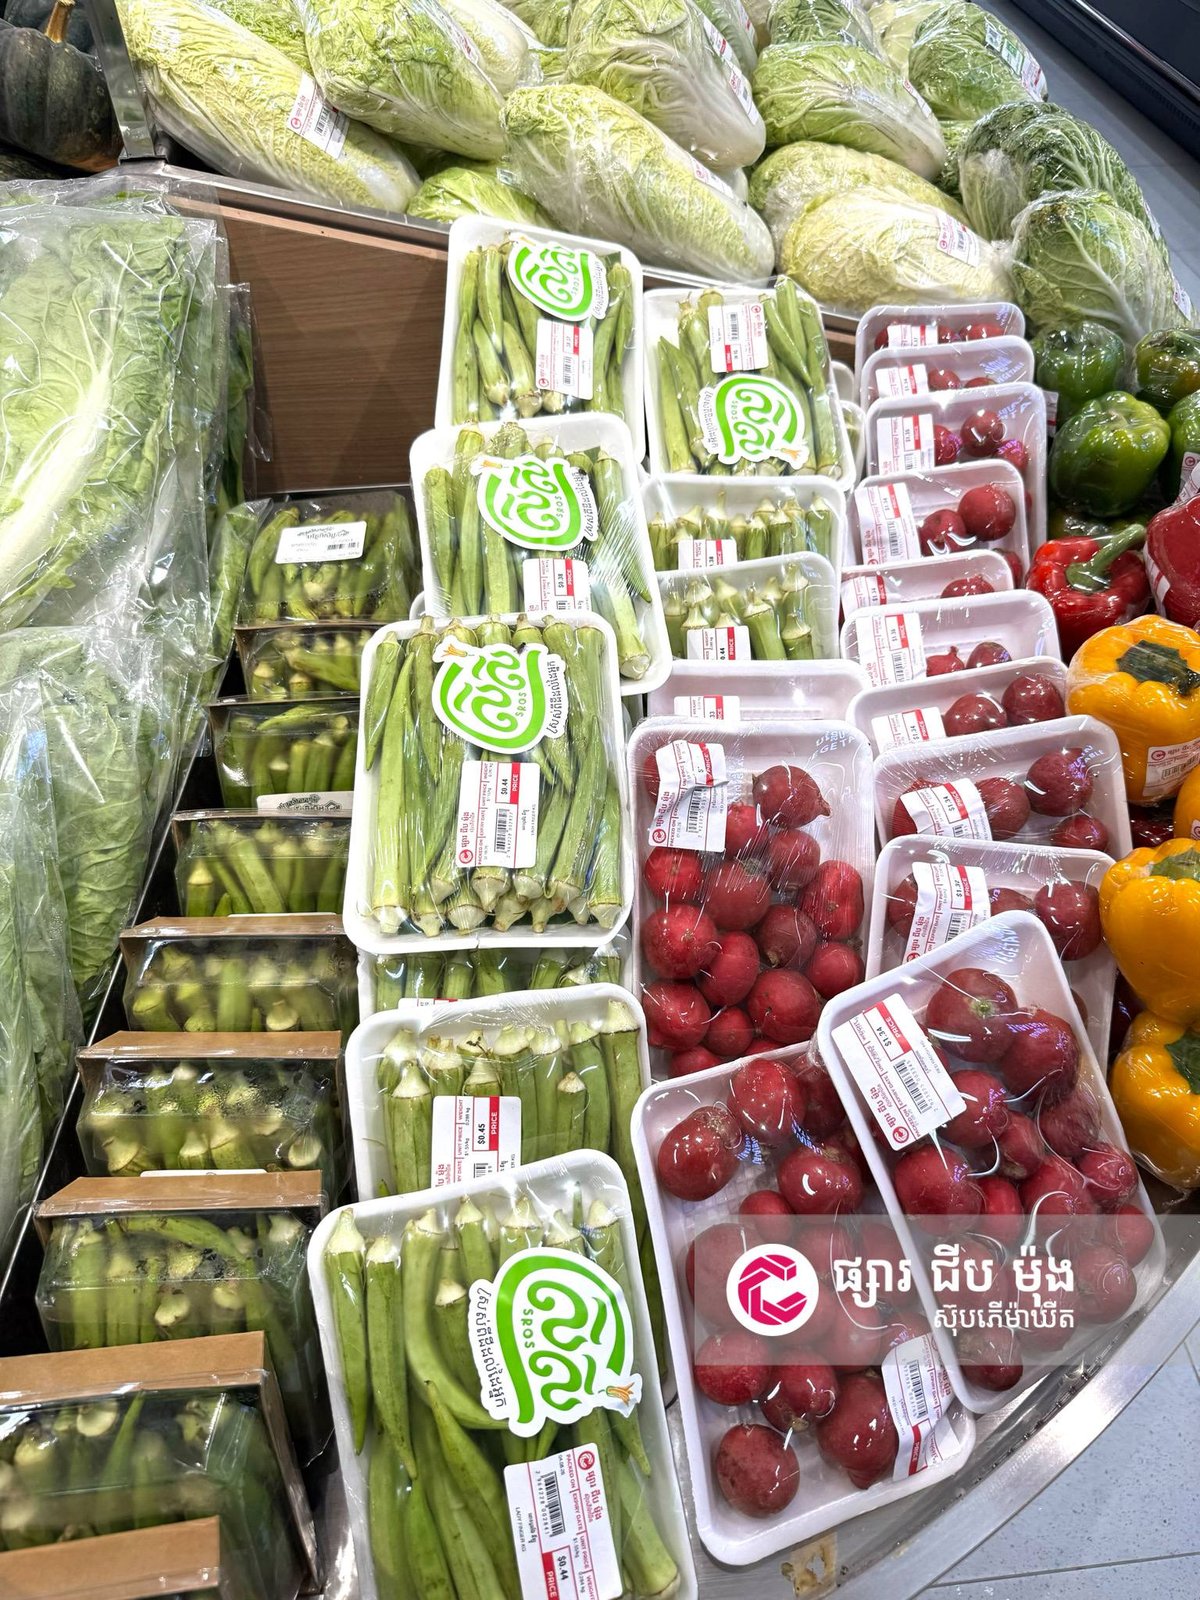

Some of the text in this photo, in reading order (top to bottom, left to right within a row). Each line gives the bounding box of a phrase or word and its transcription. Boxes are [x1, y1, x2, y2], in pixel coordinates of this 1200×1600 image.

[556, 495, 564, 518] SROS
[516, 693, 527, 717] SROS
[500, 778, 508, 794] $0.44
[943, 794, 954, 812] $1.34
[951, 789, 962, 807] PRICE
[952, 879, 963, 897] $1.32
[960, 877, 972, 896] PRICE
[875, 1026, 891, 1047] $1.34
[885, 1016, 901, 1038] PRICE
[867, 1085, 882, 1100] ម៉ុង
[883, 1075, 903, 1106] EXPIRY DATE
[873, 1099, 887, 1113] ជីប
[902, 1108, 910, 1117] ON
[490, 1111, 498, 1134] PRICE
[907, 1117, 921, 1136] PACKED
[477, 1123, 486, 1144] $0.45
[522, 1309, 534, 1349] SROS
[931, 1390, 939, 1405] DATE
[565, 1453, 575, 1488] PACKED ON
[584, 1470, 604, 1520] ផ្សារ ជីប ម៉ុង
[516, 1521, 525, 1542] FINGER
[520, 1543, 526, 1552] KG
[556, 1555, 569, 1580] $0.44
[581, 1550, 589, 1568] PRICE
[545, 1571, 557, 1597] PRICE
